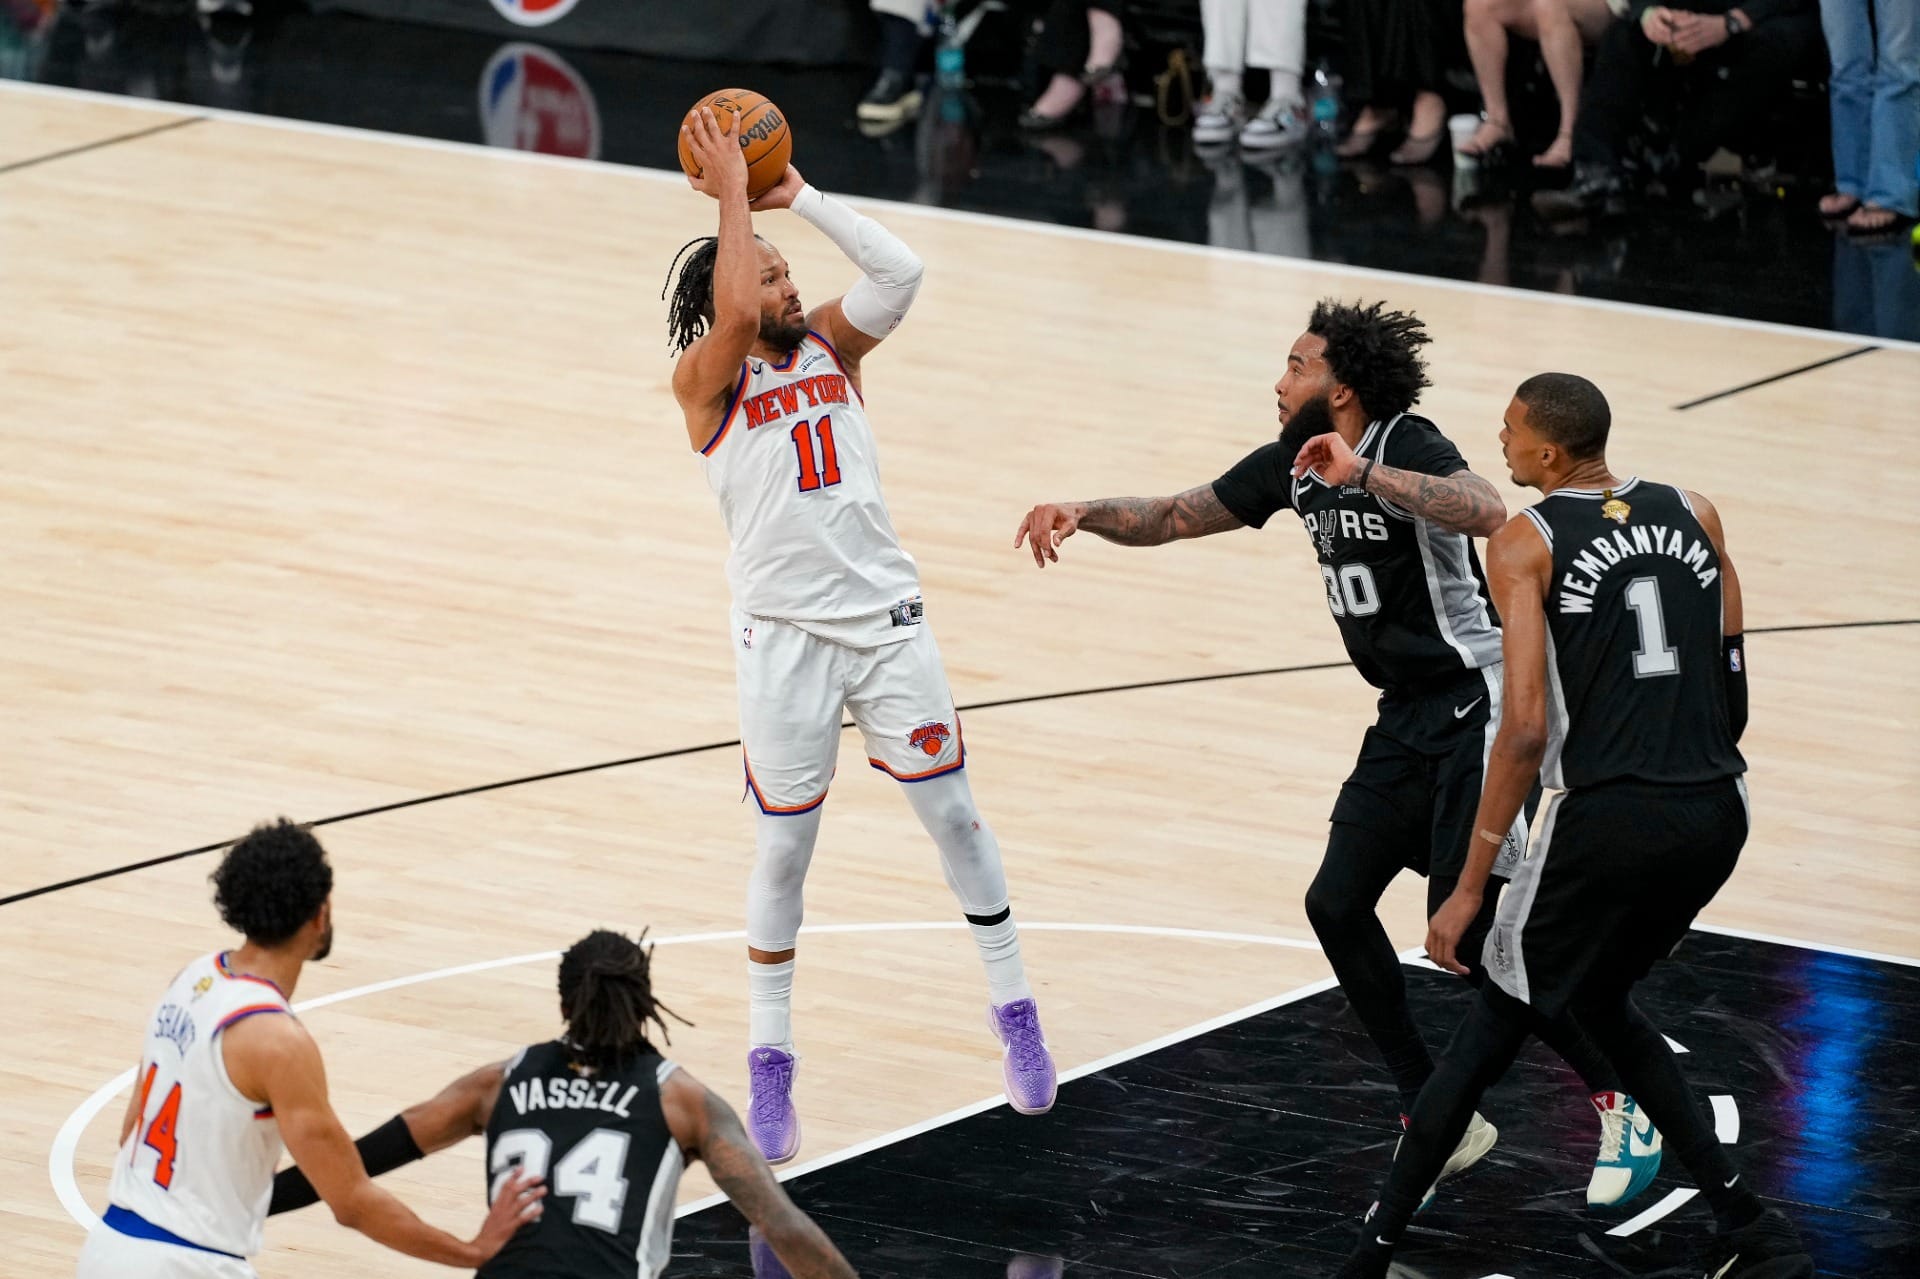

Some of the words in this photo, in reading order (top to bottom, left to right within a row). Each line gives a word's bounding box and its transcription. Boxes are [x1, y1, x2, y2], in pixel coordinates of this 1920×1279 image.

[739, 109, 783, 147] Wilso
[742, 384, 799, 431] NEW
[797, 373, 850, 409] YORK
[790, 414, 842, 492] 11
[1303, 508, 1389, 556] PURS
[1320, 562, 1382, 618] 30
[1559, 525, 1718, 614] WEMBANYAMA
[1624, 575, 1680, 679] 1
[509, 1077, 640, 1119] VASSELL
[490, 1127, 632, 1236] 24
